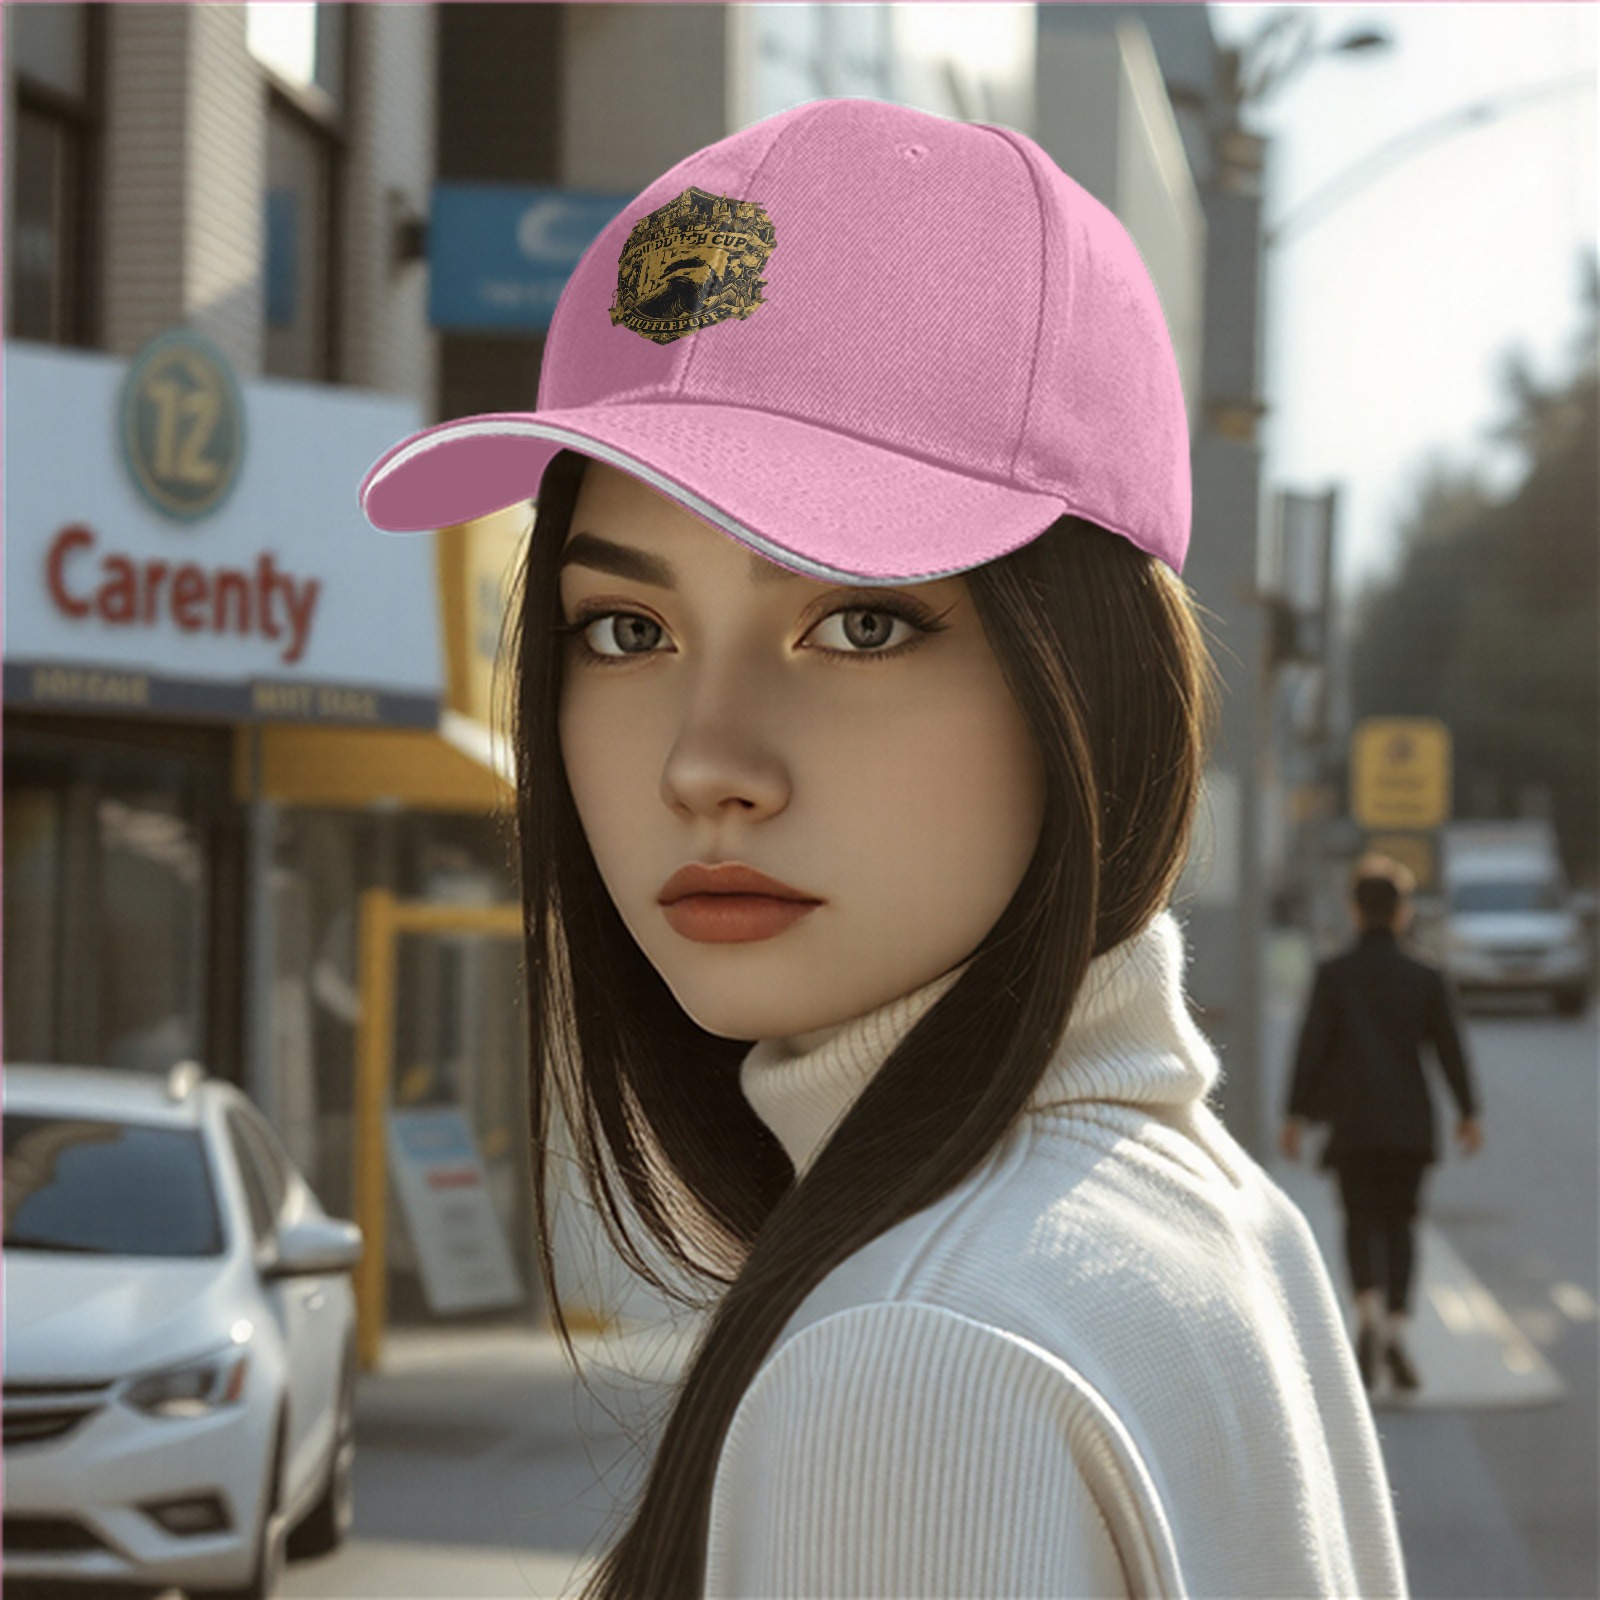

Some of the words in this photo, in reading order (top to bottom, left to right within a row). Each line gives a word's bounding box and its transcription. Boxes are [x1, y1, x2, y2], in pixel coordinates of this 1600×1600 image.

[633, 233, 708, 257] QUDDITCH
[711, 233, 749, 248] CUP
[626, 310, 719, 331] HUFFLEPUFF
[45, 524, 321, 664] Carenty
